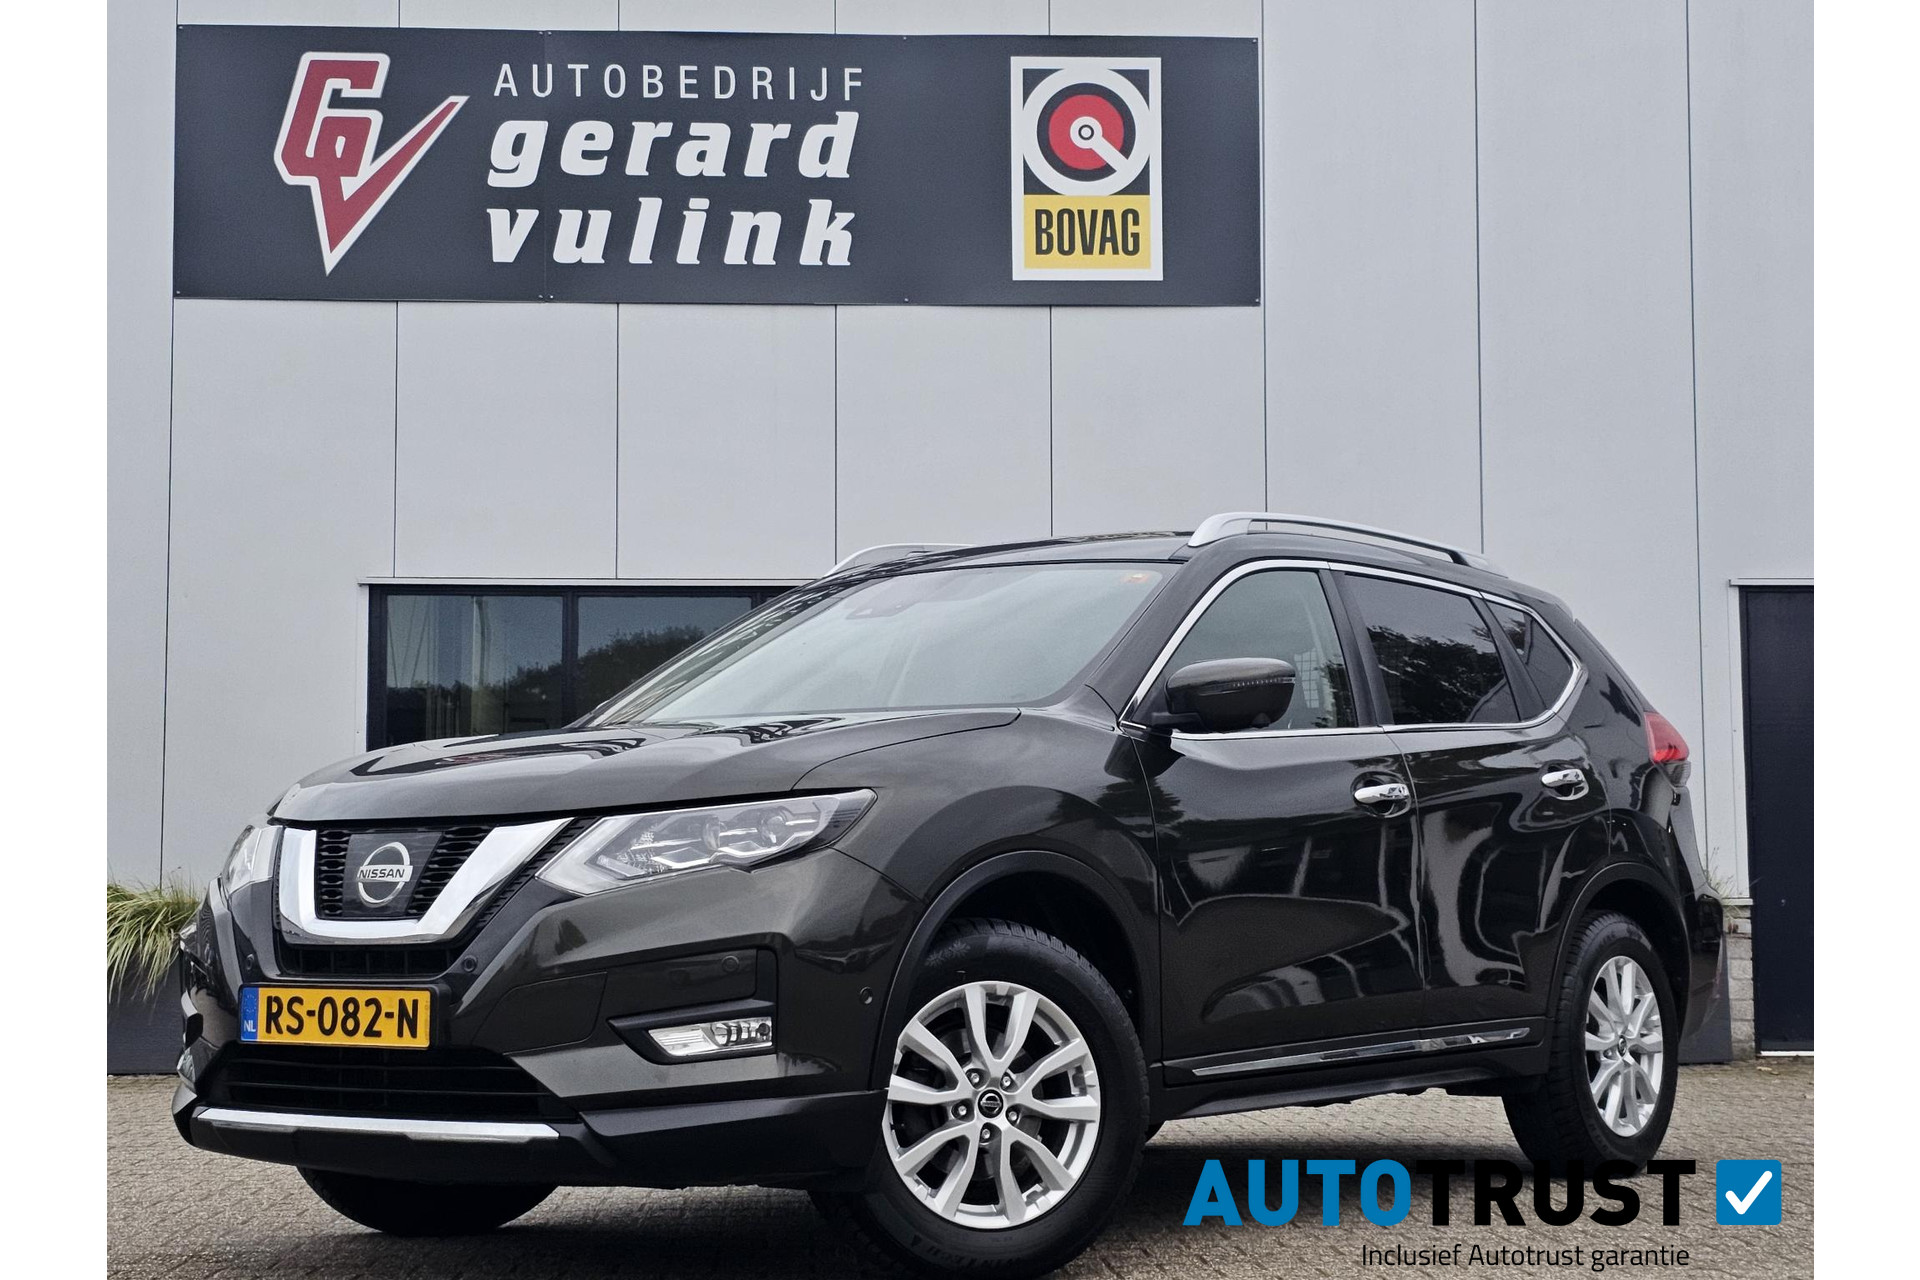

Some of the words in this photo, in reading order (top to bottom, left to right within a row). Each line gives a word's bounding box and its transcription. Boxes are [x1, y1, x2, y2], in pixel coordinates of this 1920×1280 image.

[494, 64, 862, 101] AUTOBEDRIJF
[488, 112, 859, 187] gerard
[487, 198, 855, 265] vulink
[1036, 209, 1139, 255] BOVAG
[359, 868, 405, 878] NISSAN
[243, 1019, 256, 1032] NL
[265, 996, 419, 1039] RS-082-N
